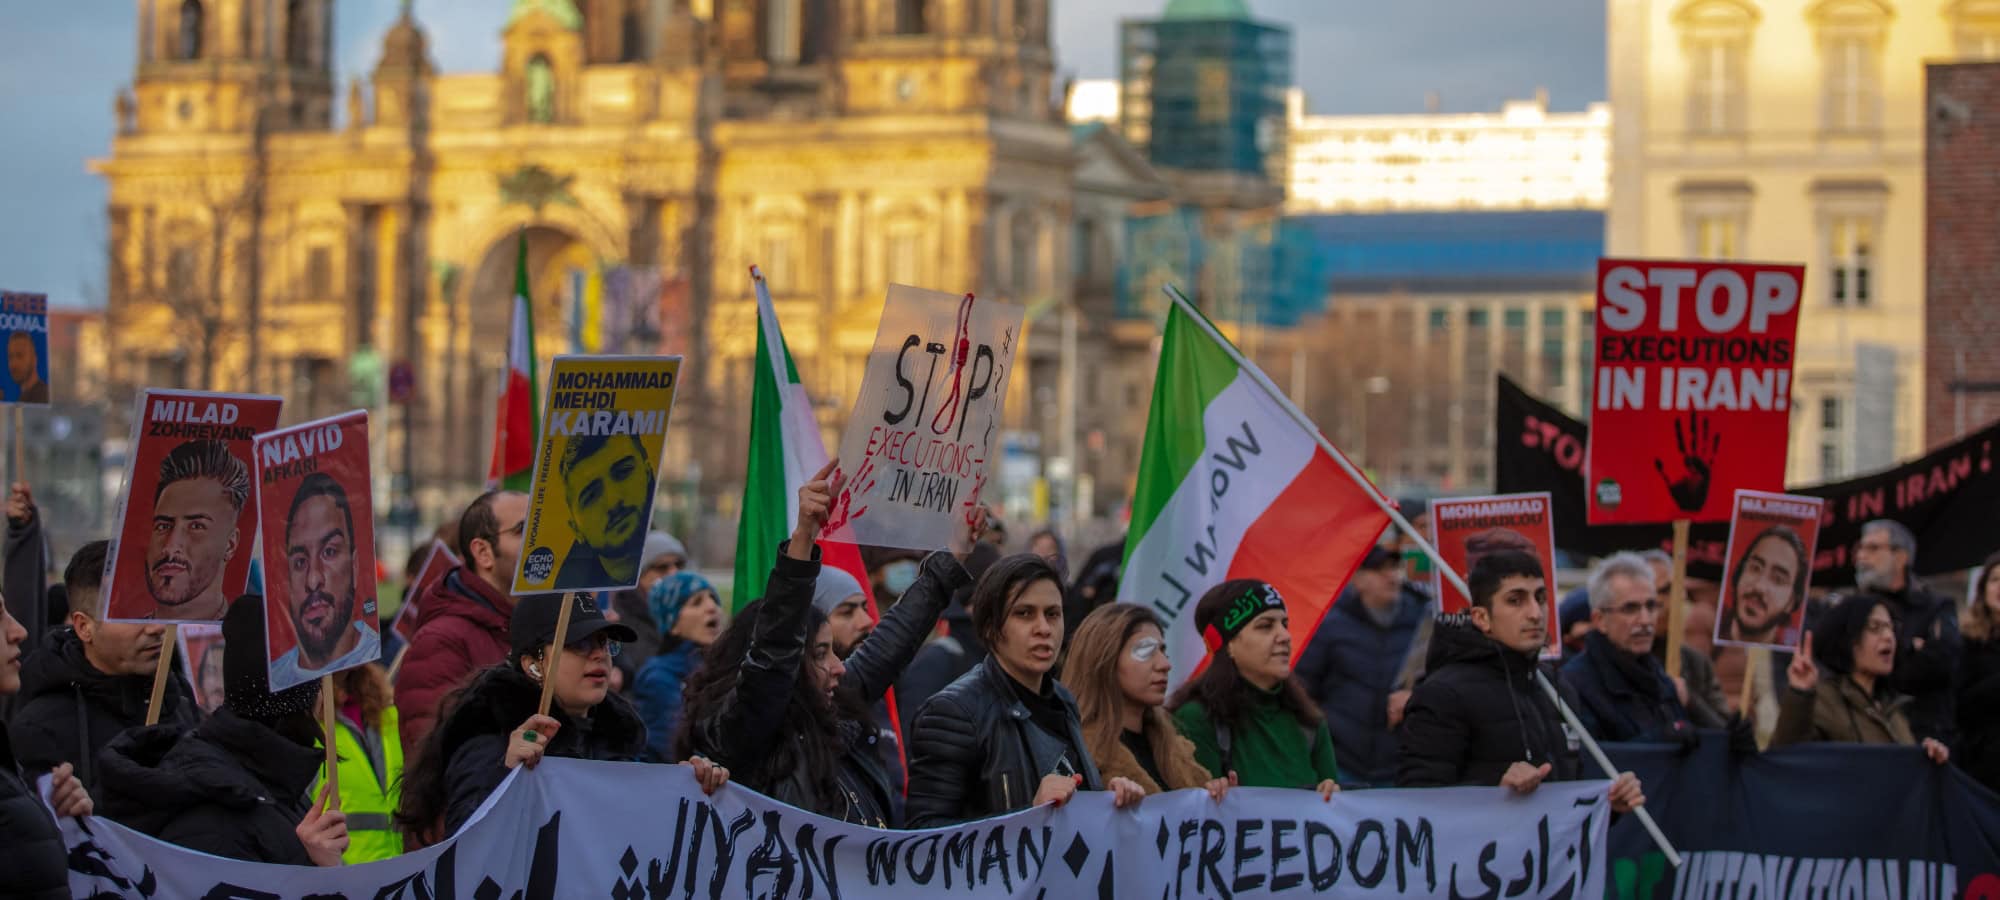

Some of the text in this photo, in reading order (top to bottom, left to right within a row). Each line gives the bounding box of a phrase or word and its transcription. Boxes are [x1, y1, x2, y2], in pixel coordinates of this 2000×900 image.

[1602, 267, 1799, 333] STOP
[1601, 336, 1790, 364] EXECUTIONS
[557, 372, 672, 389] MOHAMMAD
[884, 333, 994, 441] STOP
[1598, 367, 1791, 411] IN IRAN!
[152, 399, 239, 425] MILAD
[553, 391, 616, 409] MEHDI
[549, 410, 667, 436] KARAMI
[263, 424, 342, 467] NAVID
[865, 425, 977, 478] EXECUTIONS
[1522, 416, 1586, 477] STO
[263, 457, 317, 483] AFKARI
[888, 468, 959, 513] IN IRAN
[528, 508, 542, 548] WOMAN
[536, 487, 545, 505] LIFE
[1441, 500, 1543, 519] MOHAMMAD
[528, 554, 553, 564] ECHO
[531, 563, 553, 573] IRAN
[647, 797, 848, 900] JIYAN
[866, 825, 1052, 894] WOMAN
[1176, 817, 1436, 900] FREEDOM
